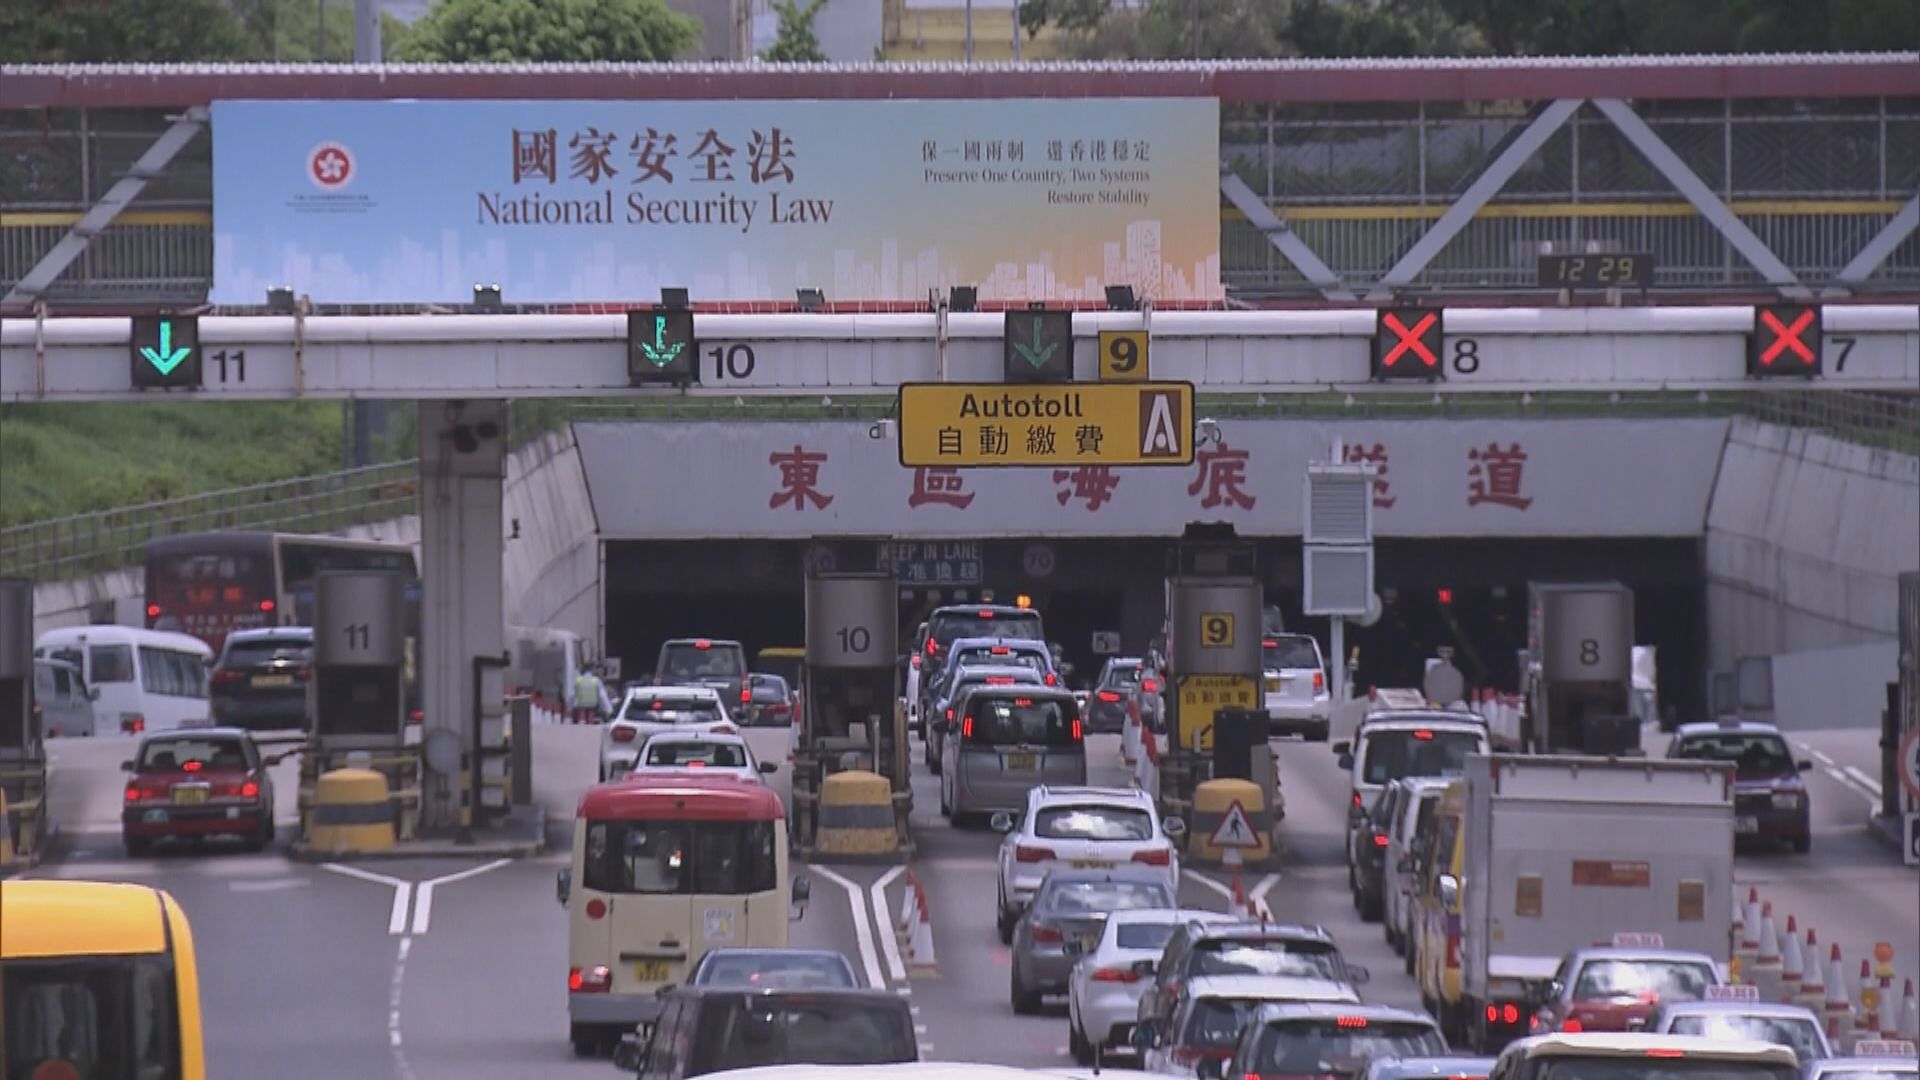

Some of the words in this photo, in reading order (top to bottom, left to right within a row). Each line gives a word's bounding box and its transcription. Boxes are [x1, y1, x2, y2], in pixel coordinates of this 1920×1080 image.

[512, 127, 796, 185] 國家安全法
[922, 139, 1024, 162] 保一國兩制
[1047, 139, 1150, 162] 還香港穩定
[924, 169, 978, 184] Preserve
[982, 169, 1008, 182] One
[1011, 169, 1066, 185] Country,
[1072, 168, 1096, 182] Two
[1099, 168, 1150, 184] Systems
[1047, 190, 1094, 204] Restore
[1098, 189, 1150, 206] Stability
[478, 190, 612, 225] National
[627, 190, 757, 234] Security
[771, 192, 834, 225] Law
[1597, 256, 1634, 281] 29
[209, 349, 245, 383] 11
[708, 343, 756, 380] 10
[1109, 337, 1138, 373] 9
[1453, 339, 1480, 374] 8
[1831, 338, 1856, 372] 7
[959, 393, 1083, 418] Autotoll
[938, 424, 1104, 456] 自動繳費
[923, 544, 938, 561] IN
[944, 544, 979, 561] LANE
[343, 624, 369, 650] 11
[836, 626, 870, 653] 10
[1208, 617, 1228, 644] 9
[1579, 639, 1600, 666] 8
